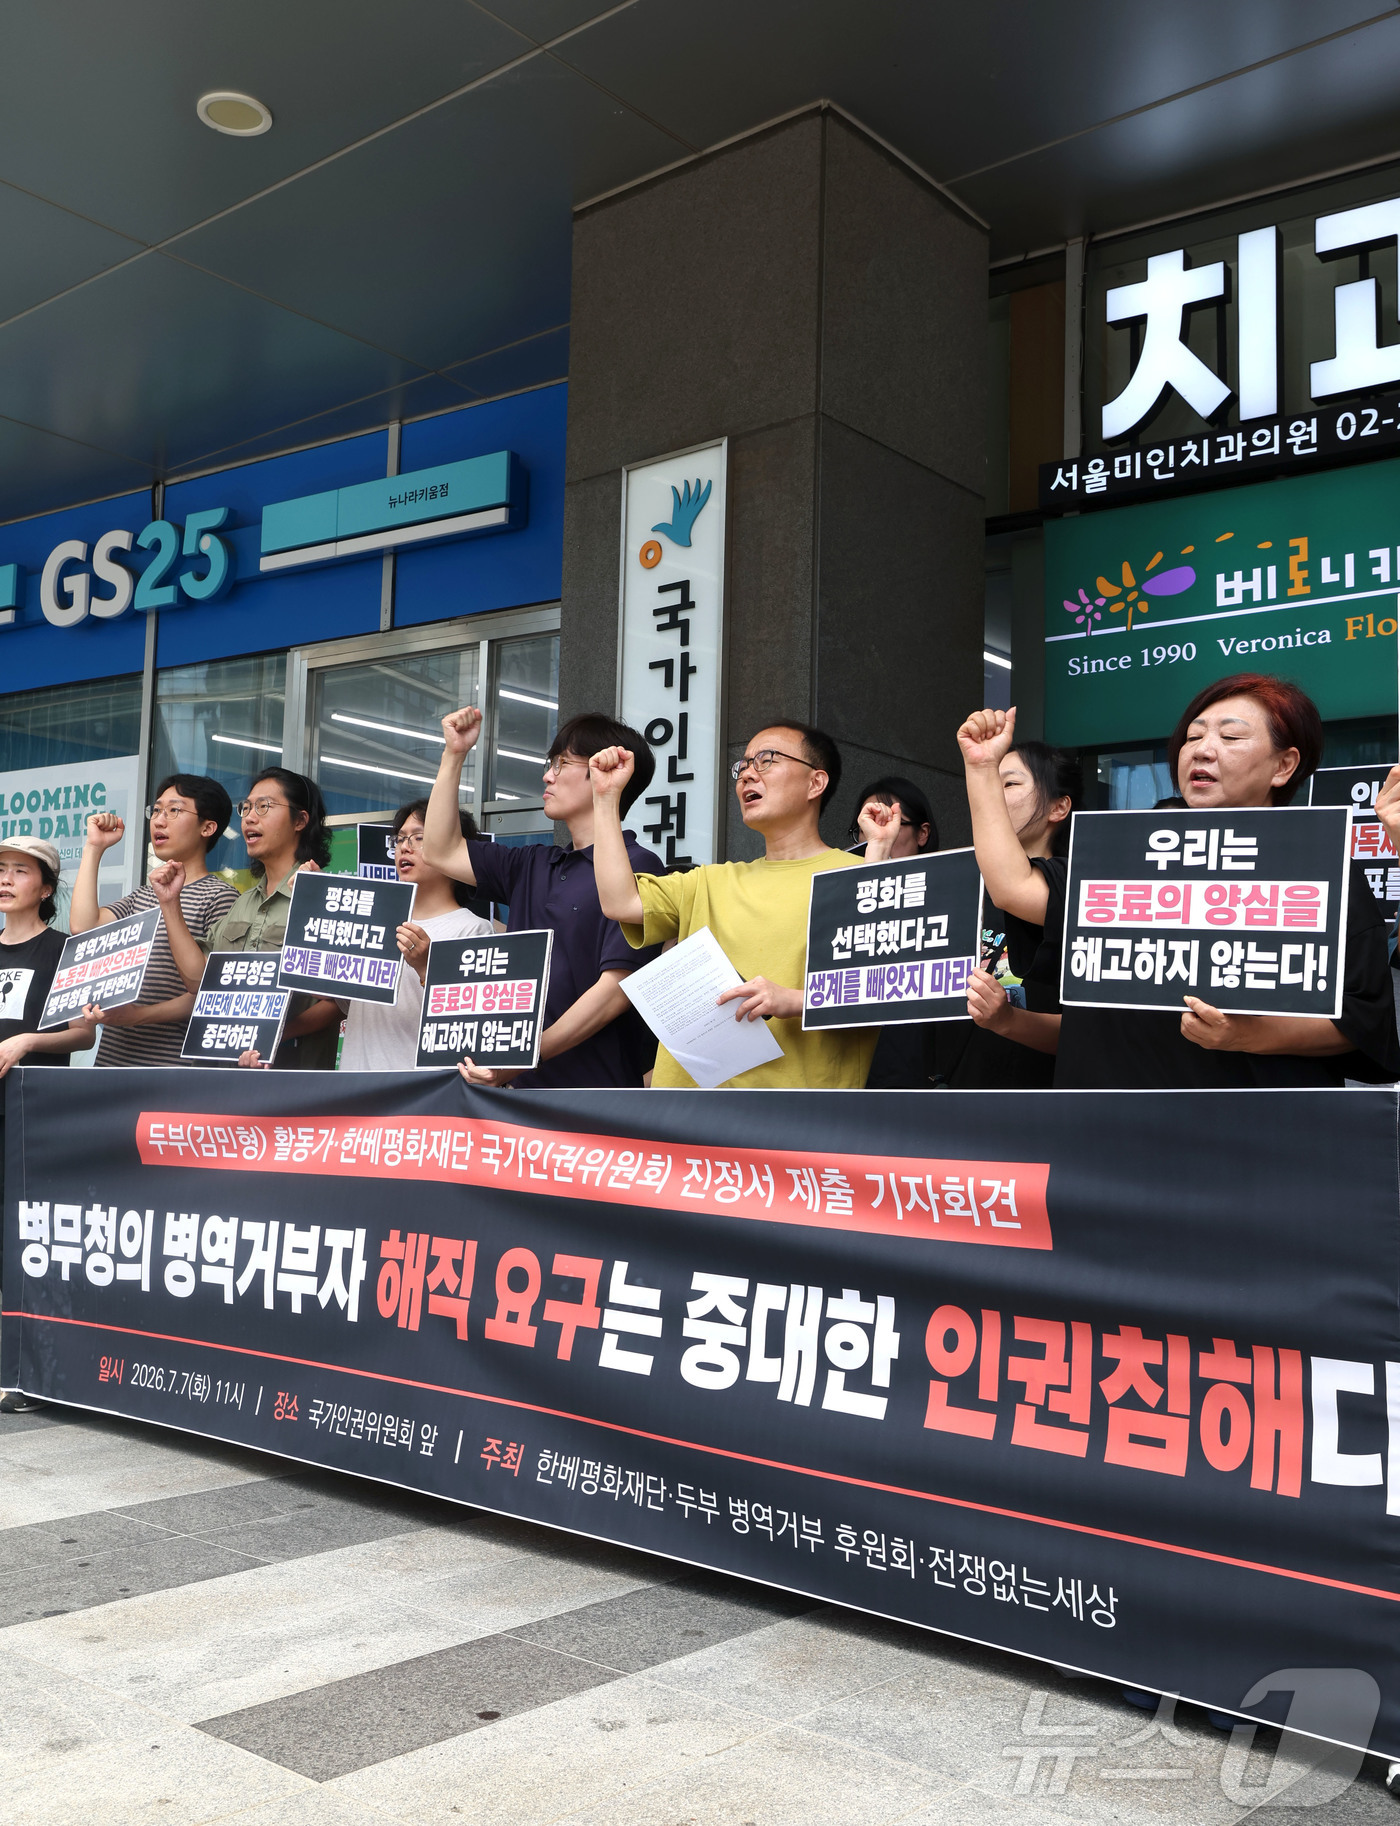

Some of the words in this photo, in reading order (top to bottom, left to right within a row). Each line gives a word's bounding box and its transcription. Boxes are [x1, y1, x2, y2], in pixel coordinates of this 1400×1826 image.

[1050, 418, 1318, 493] 서울미인치과의원
[1336, 402, 1400, 441] 02-
[389, 482, 449, 509] 뉴나라키움점
[40, 506, 232, 628] GS25
[1068, 655, 1132, 676] Since
[1141, 642, 1197, 667] 1990
[1217, 627, 1332, 657] Veronica
[643, 579, 696, 865] 국가인권
[39, 809, 117, 840] DAI
[1145, 828, 1259, 871] 우리는
[325, 886, 375, 917] 평화를
[856, 872, 927, 914] 평화를
[1084, 883, 1192, 925] 동료의
[1204, 884, 1321, 928] 양심을
[74, 921, 144, 962] 병역거부자의
[304, 917, 385, 950] 선택했다고
[831, 914, 949, 960] 선택했다고
[53, 963, 89, 990] 노동권
[89, 947, 147, 978] 빼앗으려는
[220, 960, 276, 985] 병무청은
[284, 947, 322, 976] 생계를
[323, 953, 364, 983] 빼앗지
[367, 960, 397, 988] 마라
[459, 947, 509, 977] 우리는
[809, 969, 861, 1007] 생계를
[866, 963, 925, 1000] 빼앗지
[930, 958, 972, 996] 마라
[1070, 936, 1200, 987] 해고하지
[1210, 940, 1329, 992] 않는다!
[46, 985, 92, 1017] 병무청을
[92, 970, 141, 1002] 규탄한다
[195, 993, 234, 1016] 시민단체
[232, 994, 263, 1017] 인사권
[262, 995, 285, 1018] 개입
[430, 984, 478, 1014] 동료의
[482, 982, 533, 1012] 양심을
[201, 1024, 259, 1051] 중단하라
[421, 1021, 478, 1053] 해고하지
[481, 1020, 533, 1052] 않는다!
[149, 1123, 267, 1162] 두부(김민형)
[480, 1134, 672, 1194] 국가인권위원회
[682, 1157, 777, 1208] 진정서
[785, 1167, 854, 1215] 제출
[865, 1172, 1022, 1230] 기자회견
[18, 1200, 155, 1292] 병무청의
[163, 1212, 367, 1323] 병역거부자
[376, 1229, 478, 1341] 해직
[484, 1247, 663, 1376] 요구는
[680, 1271, 900, 1421] 중대한
[98, 1355, 125, 1385] 일시
[130, 1362, 211, 1403] 2026.7.7(화)
[215, 1380, 245, 1411] 11시
[274, 1391, 300, 1421] 장소
[308, 1399, 416, 1452] 국가인권위원회
[420, 1423, 439, 1457] 앞
[480, 1437, 525, 1477] 주최
[536, 1449, 720, 1525] 한베평화재단·두부
[728, 1495, 825, 1554] 병역거부
